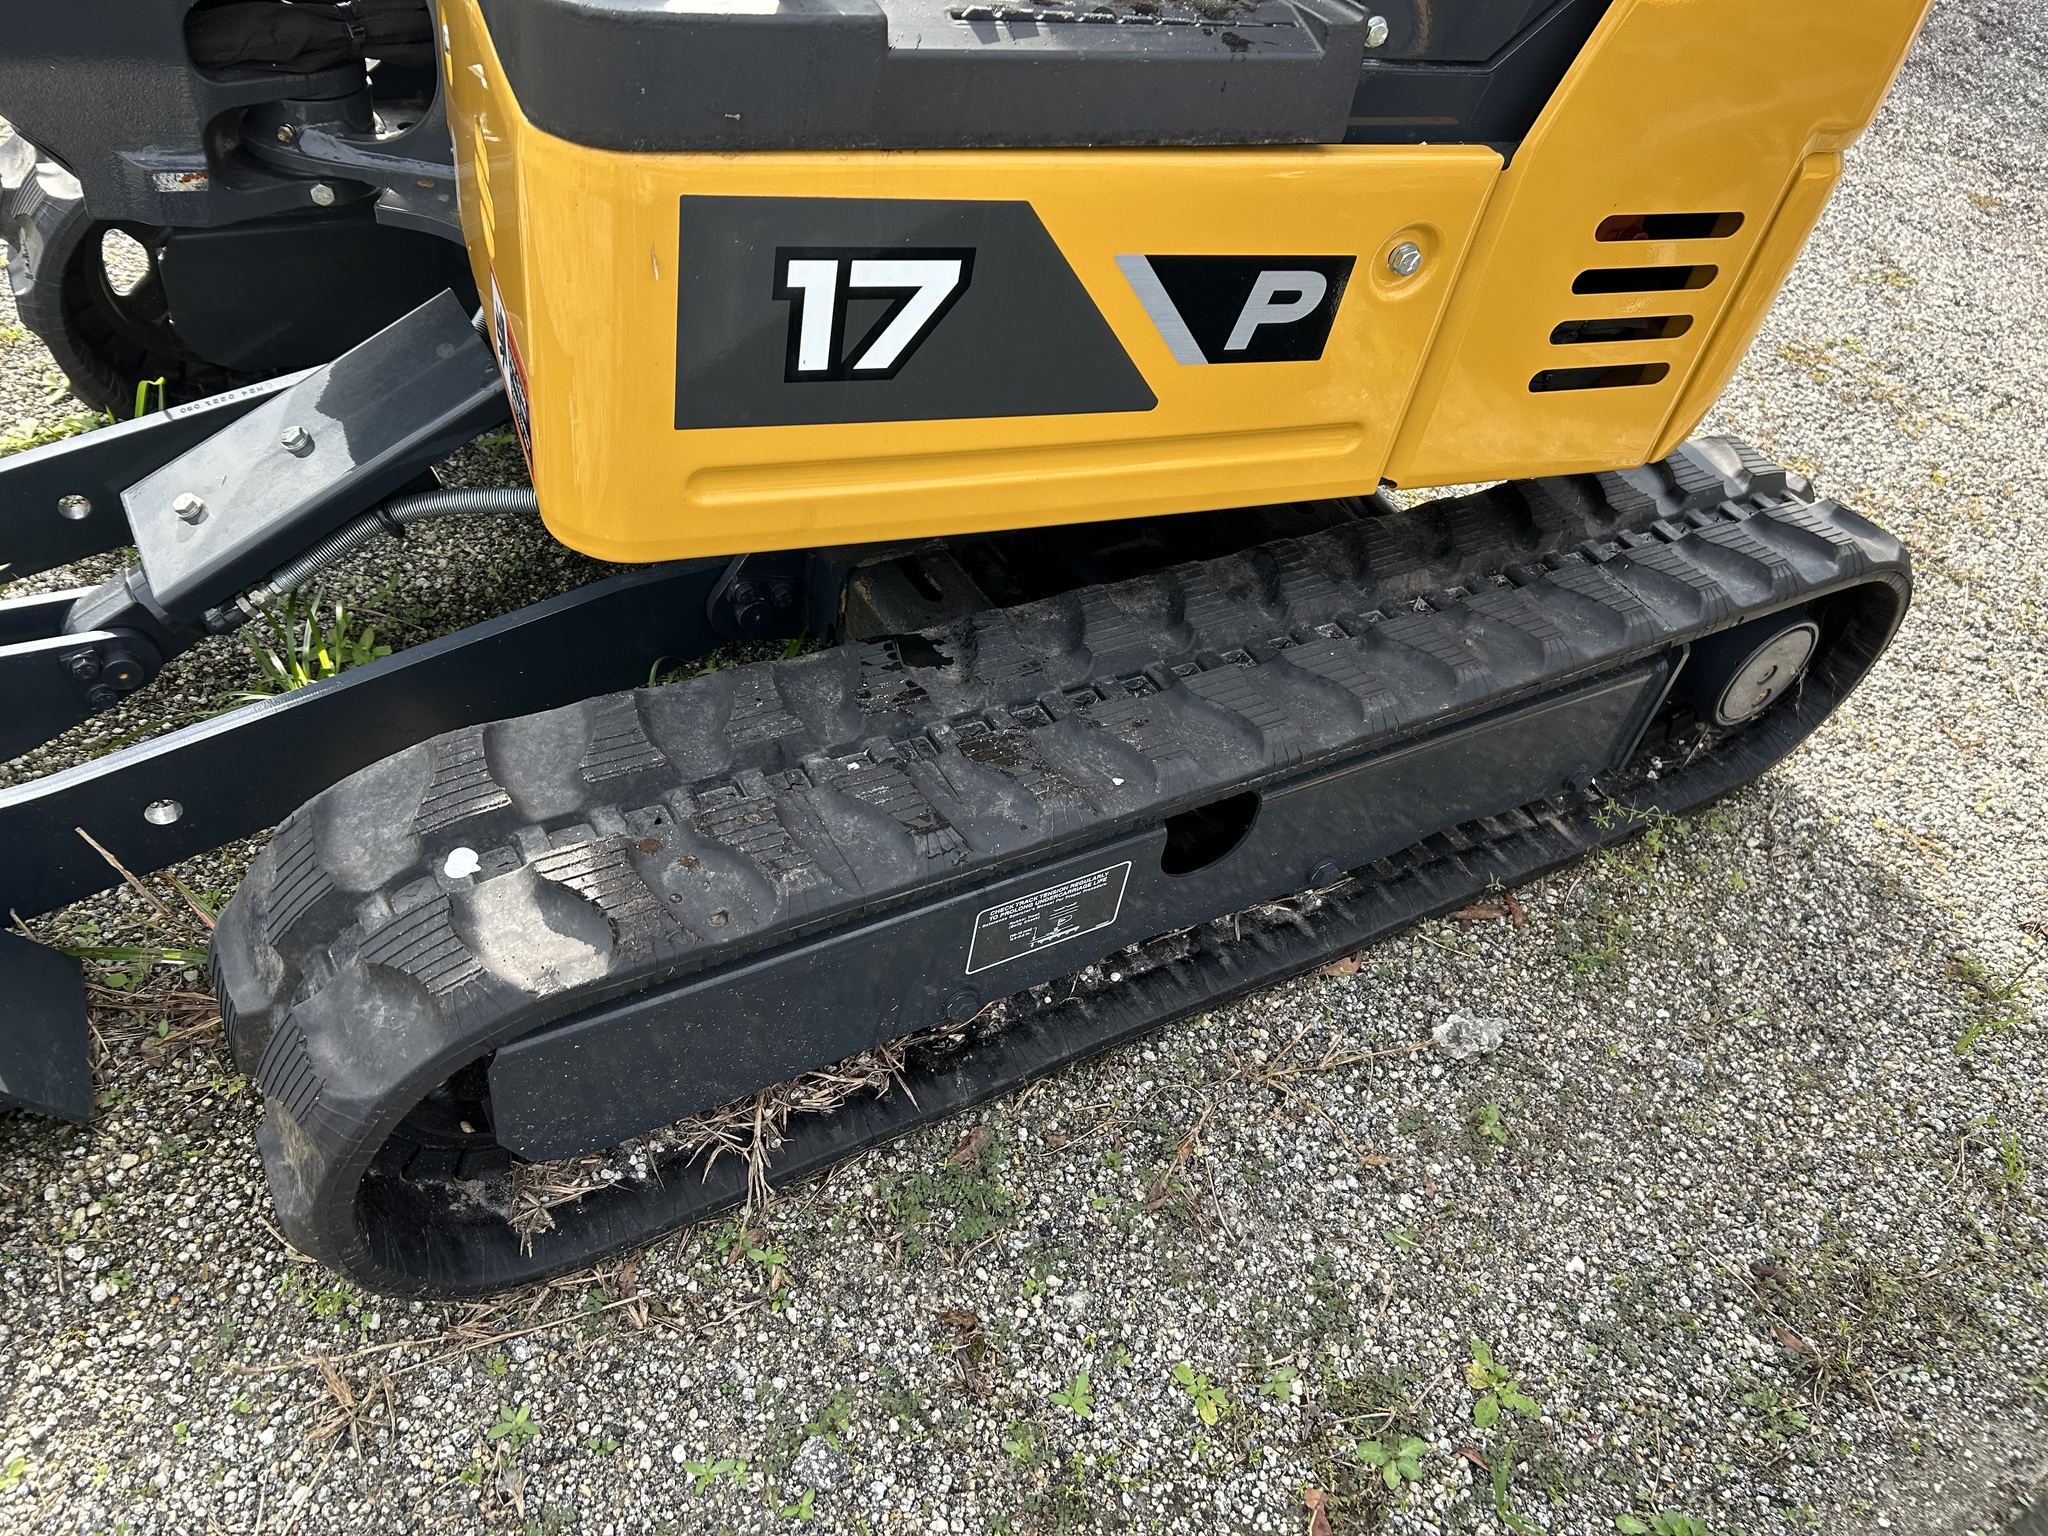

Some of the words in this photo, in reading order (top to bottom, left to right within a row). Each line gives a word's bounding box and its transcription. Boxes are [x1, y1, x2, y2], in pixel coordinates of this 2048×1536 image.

[786, 258, 963, 373] 17
[1224, 269, 1328, 351] P
[989, 904, 1014, 916] CHECK
[1015, 895, 1038, 907] TRACK
[1038, 885, 1068, 899] TENSION
[1069, 871, 1109, 888] REGULARLY
[999, 902, 1033, 917] PROLONG
[1034, 882, 1092, 905] UNDERCARRIAGE
[1092, 877, 1107, 885] LIFE
